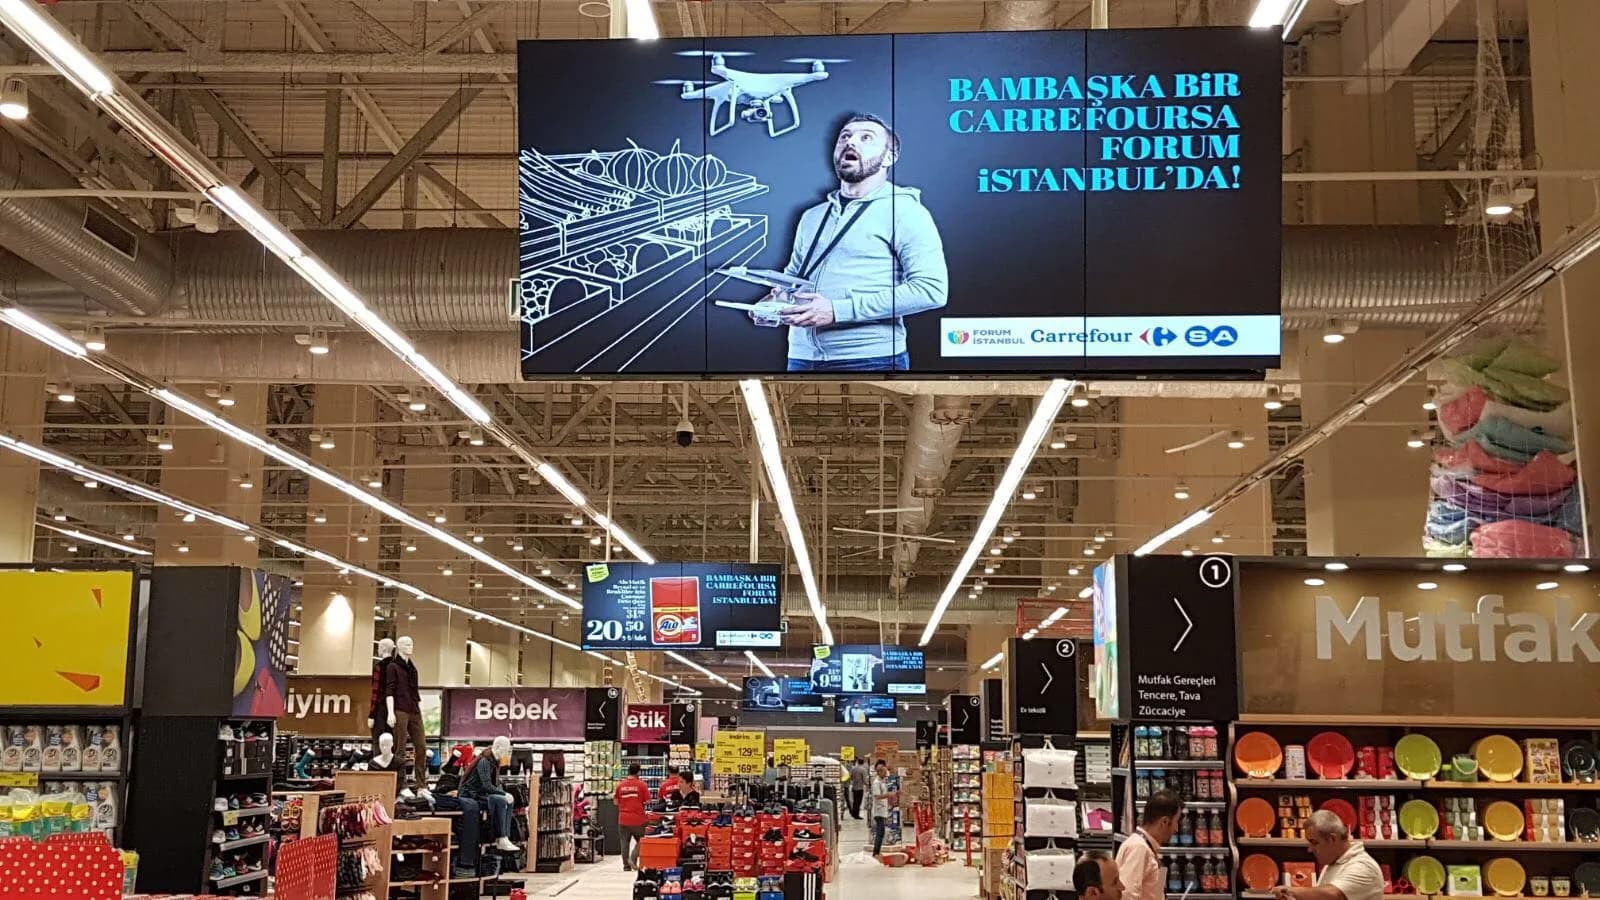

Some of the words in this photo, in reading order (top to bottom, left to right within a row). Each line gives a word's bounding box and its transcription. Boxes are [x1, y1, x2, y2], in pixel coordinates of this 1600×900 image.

[948, 74, 1166, 106] BAMBAŞKA
[949, 104, 1240, 133] CARREFOURSA
[1100, 134, 1240, 161] FORUM
[1030, 328, 1133, 343] Carrefour
[1186, 328, 1236, 344] SA
[1211, 564, 1219, 581] 1
[1315, 593, 1600, 664] Mutfak
[1061, 643, 1069, 653] 2
[1137, 674, 1171, 686] Mutfak
[1173, 674, 1216, 688] Gereçleri
[284, 687, 351, 719] iyim
[1137, 689, 1178, 702] Tencere,
[1179, 690, 1201, 701] Tava
[474, 697, 558, 721] Bebek
[1138, 705, 1186, 718] Züccaciye
[626, 710, 665, 728] etik
